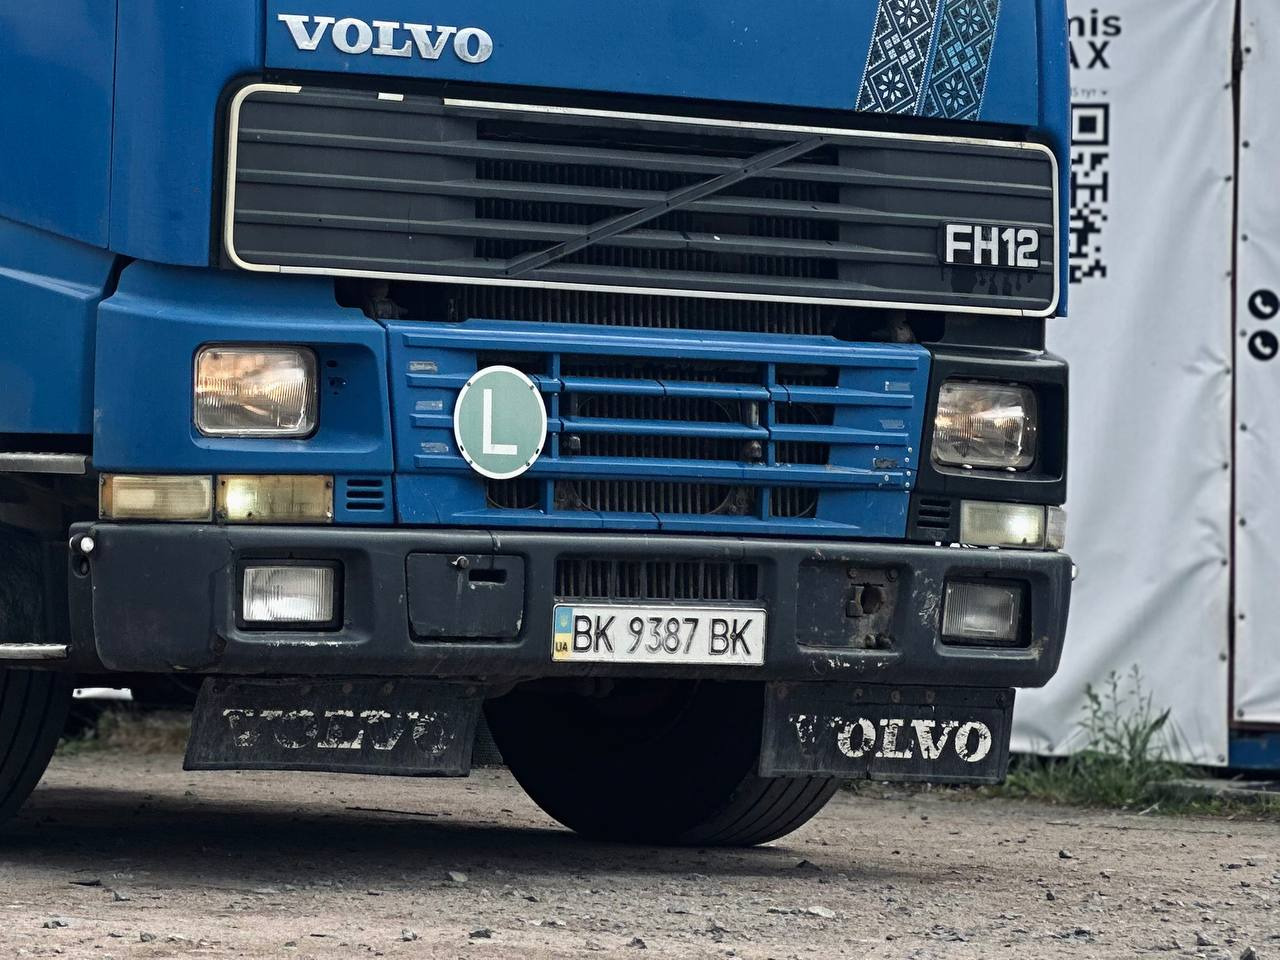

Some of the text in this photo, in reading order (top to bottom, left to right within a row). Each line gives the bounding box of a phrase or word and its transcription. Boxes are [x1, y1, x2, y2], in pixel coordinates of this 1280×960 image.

[278, 13, 493, 63] VOLVO
[946, 224, 1039, 268] FH12
[483, 388, 518, 455] L
[555, 641, 569, 653] UA
[573, 615, 753, 656] BK 9387 BK
